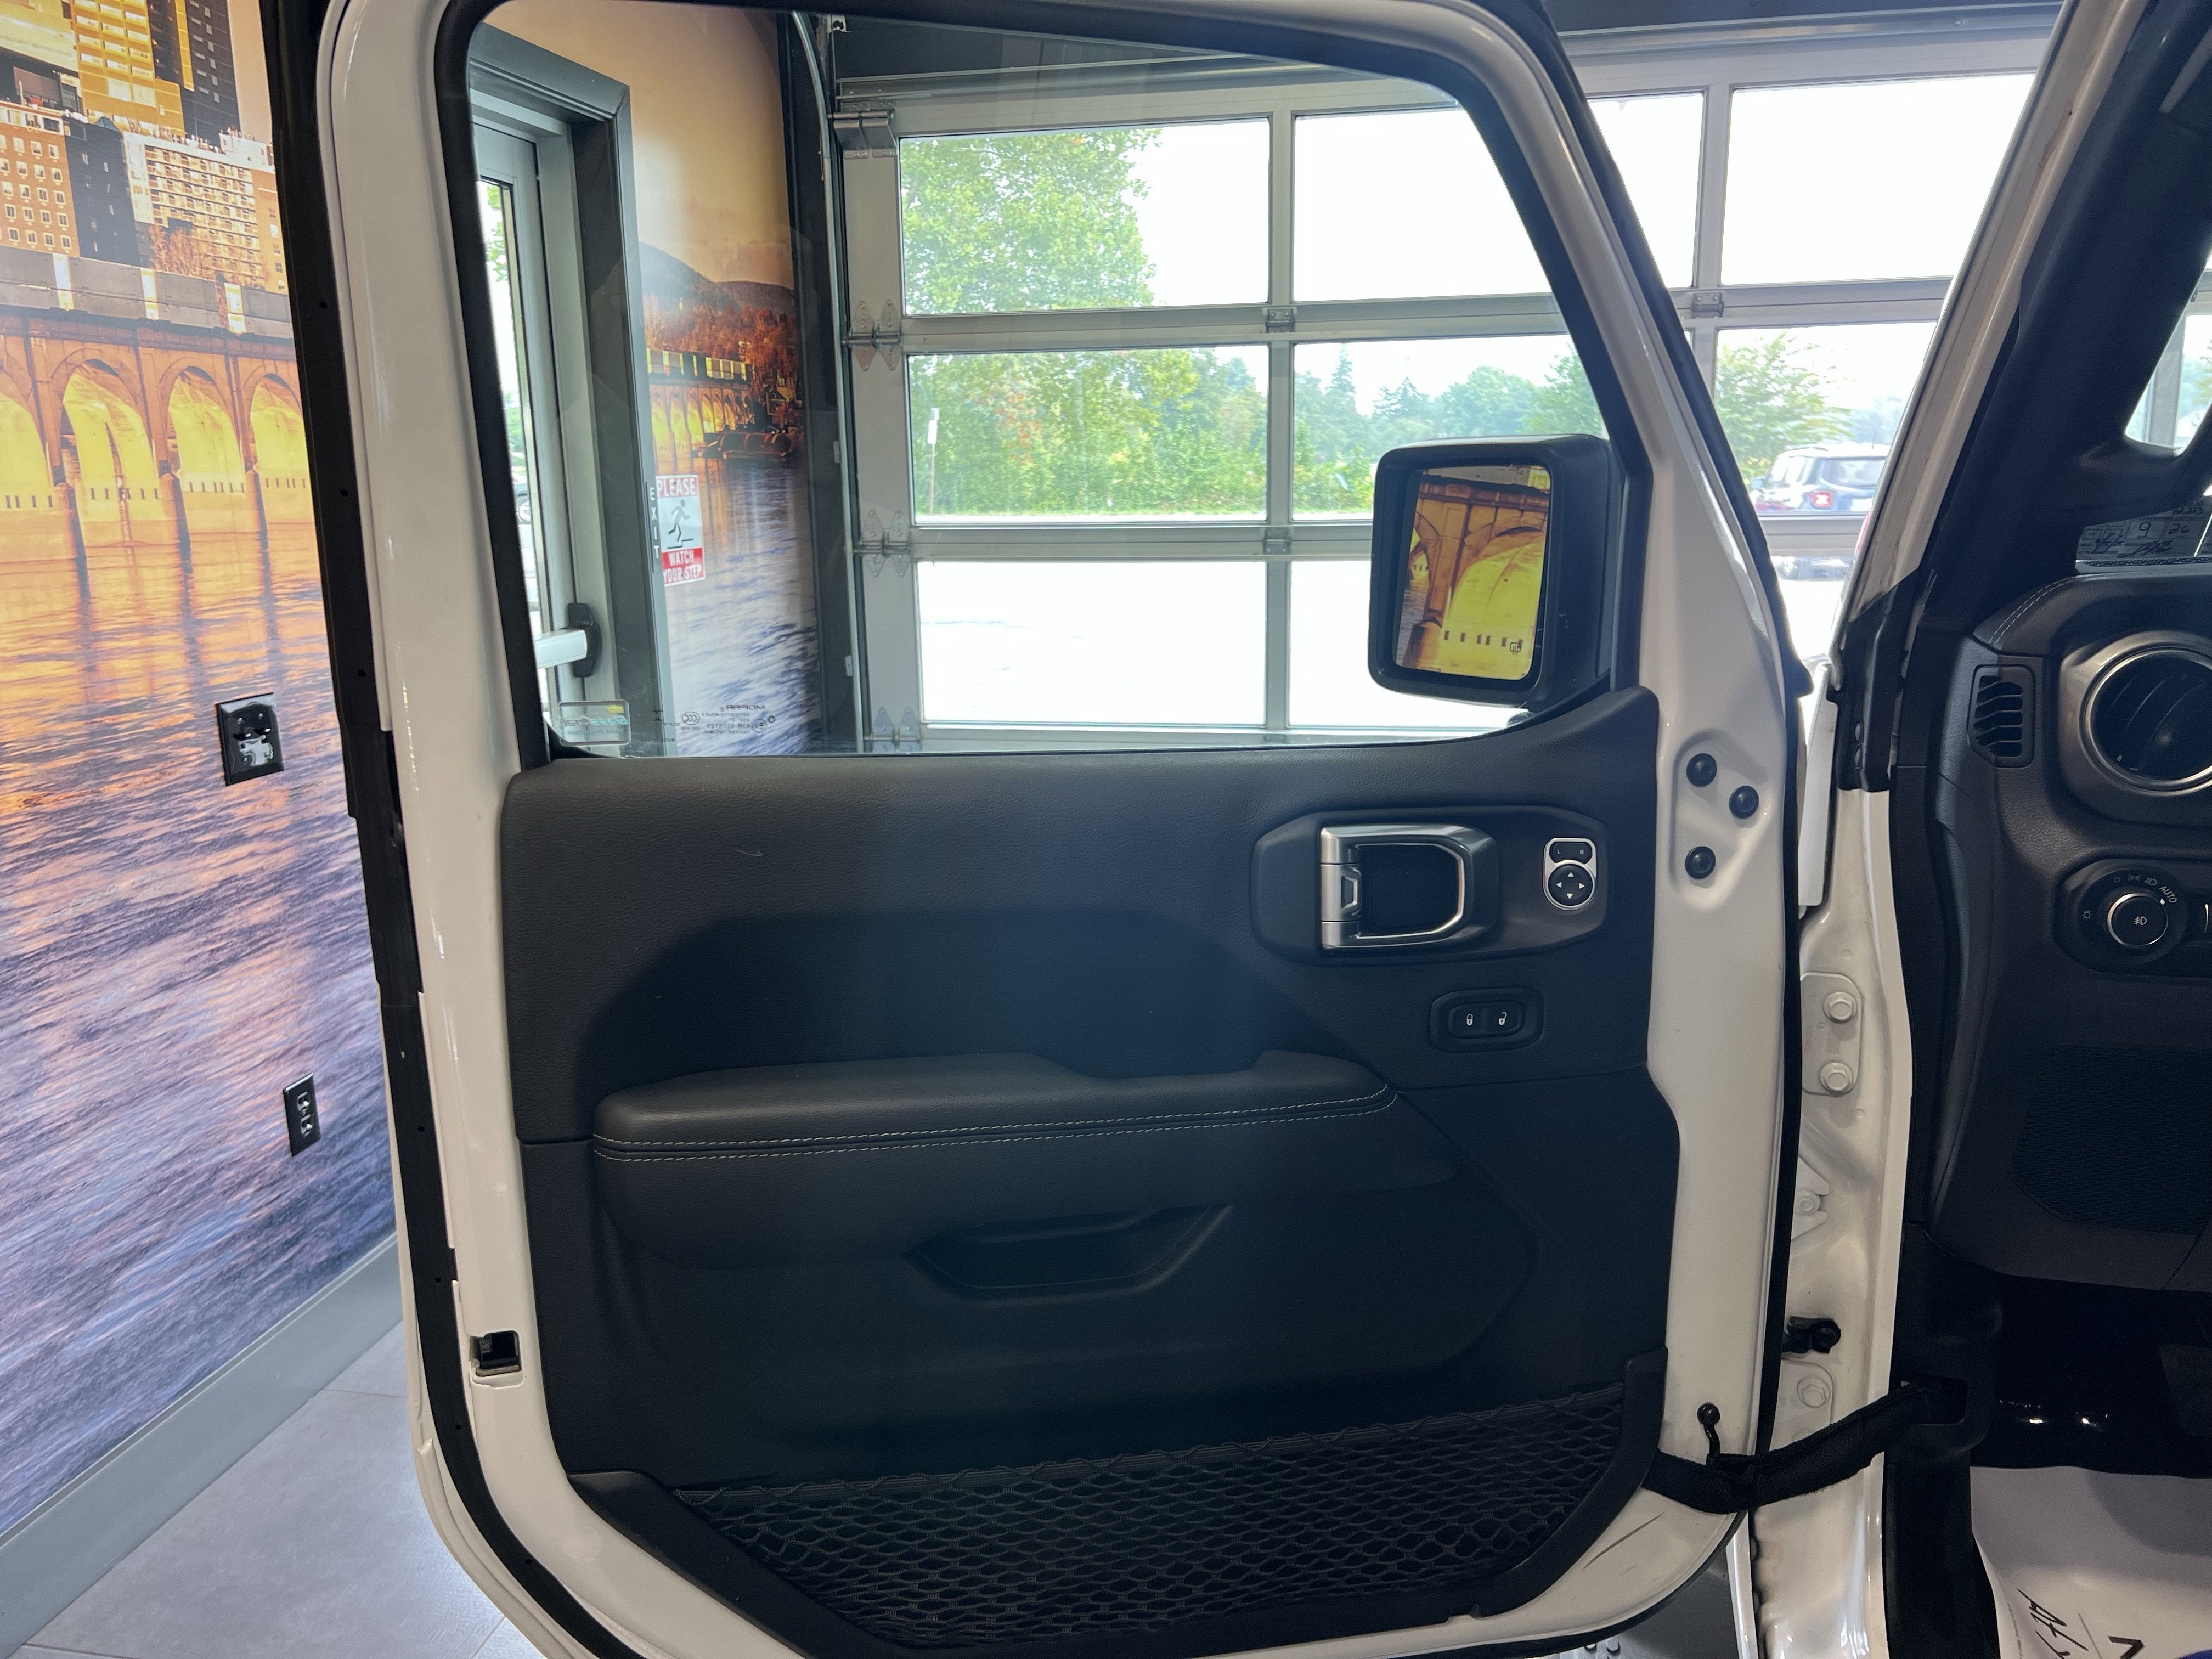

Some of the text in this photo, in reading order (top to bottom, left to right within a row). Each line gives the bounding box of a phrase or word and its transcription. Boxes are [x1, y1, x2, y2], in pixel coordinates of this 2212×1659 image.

[657, 478, 696, 496] PLEASE
[650, 487, 659, 559] EXIT
[668, 549, 695, 566] WATCH
[664, 563, 702, 583] YOUR STEP
[2159, 885, 2177, 903] AUTO
